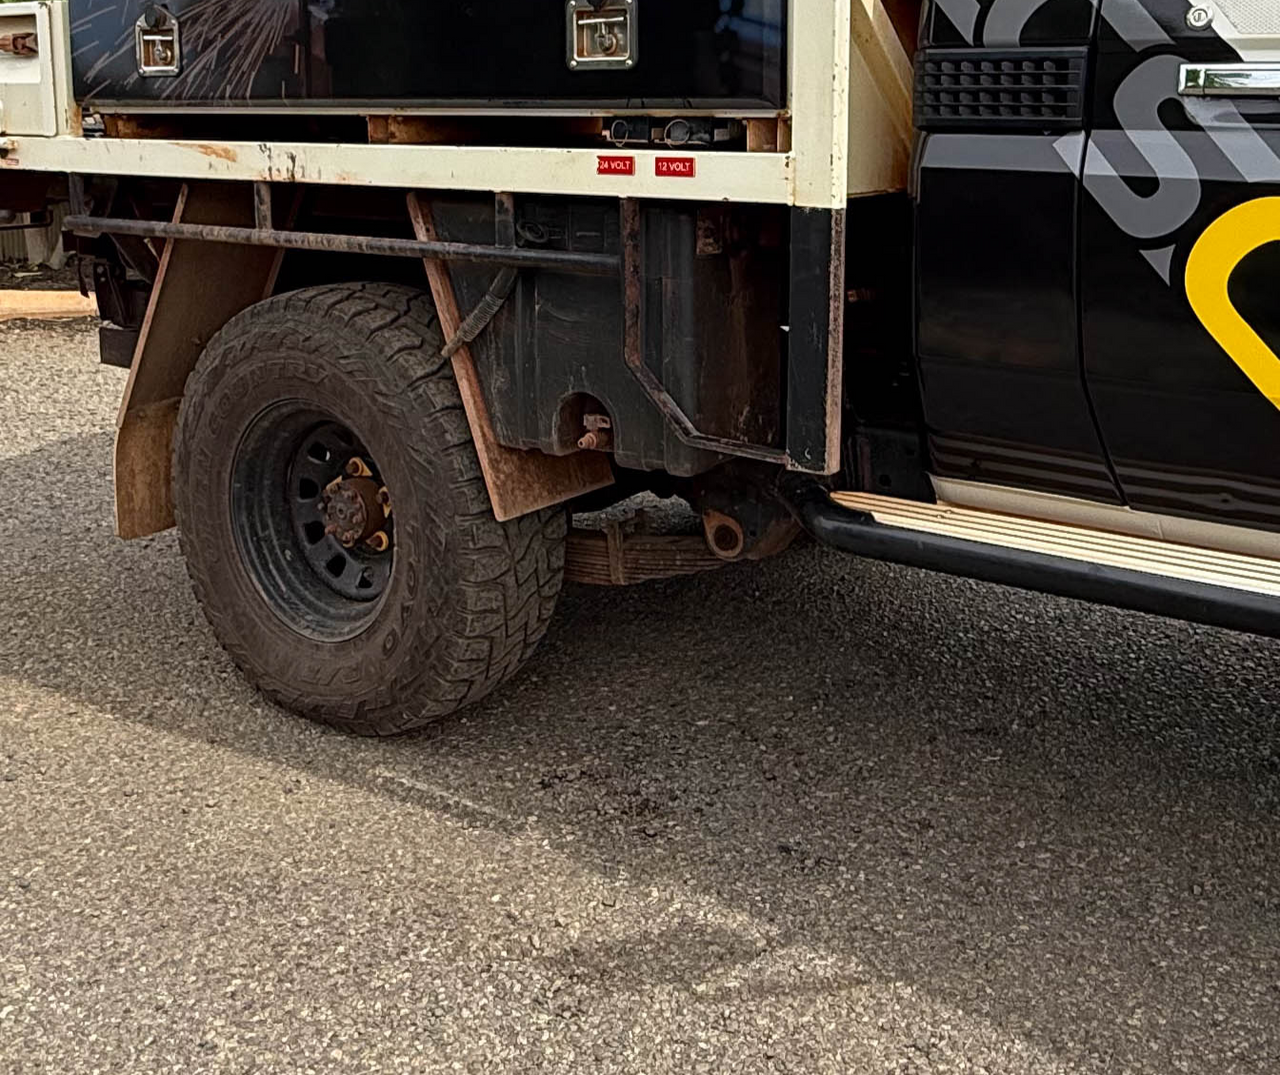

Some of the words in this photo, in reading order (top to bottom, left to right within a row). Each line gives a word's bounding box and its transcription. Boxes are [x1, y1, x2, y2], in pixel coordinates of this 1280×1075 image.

[600, 160, 609, 170] 24
[610, 161, 631, 170] VOLT
[658, 162, 668, 171] 12
[669, 162, 691, 172] VOLT
